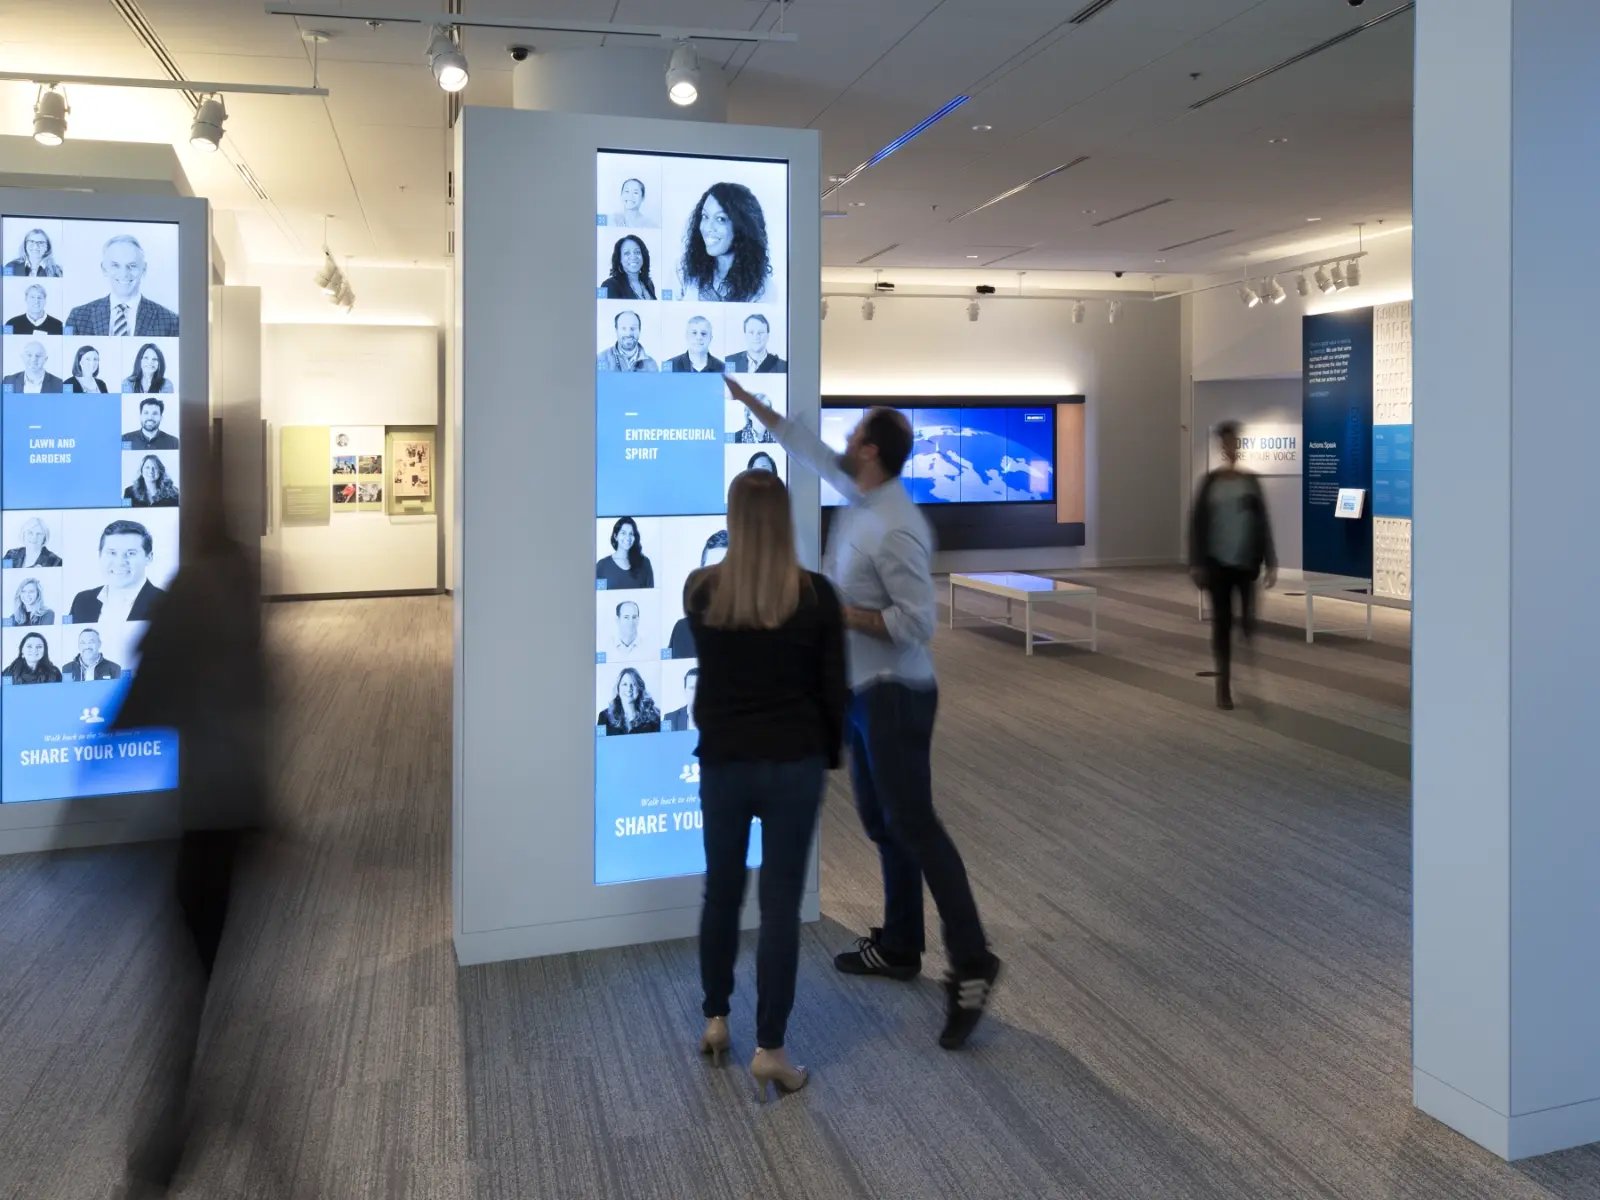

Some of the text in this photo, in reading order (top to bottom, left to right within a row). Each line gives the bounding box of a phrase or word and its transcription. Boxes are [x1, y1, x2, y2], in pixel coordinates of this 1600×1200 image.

[624, 428, 716, 441] ENTREPRENEURIAL
[29, 438, 76, 449] LAWN AND
[1260, 436, 1297, 450] BOOTH
[29, 453, 72, 464] GARDENS
[624, 447, 659, 460] SPIRIT
[1273, 450, 1297, 461] VOICE
[20, 740, 162, 766] SHARE YOUR VOICE
[615, 809, 704, 838] SHARE YOU
